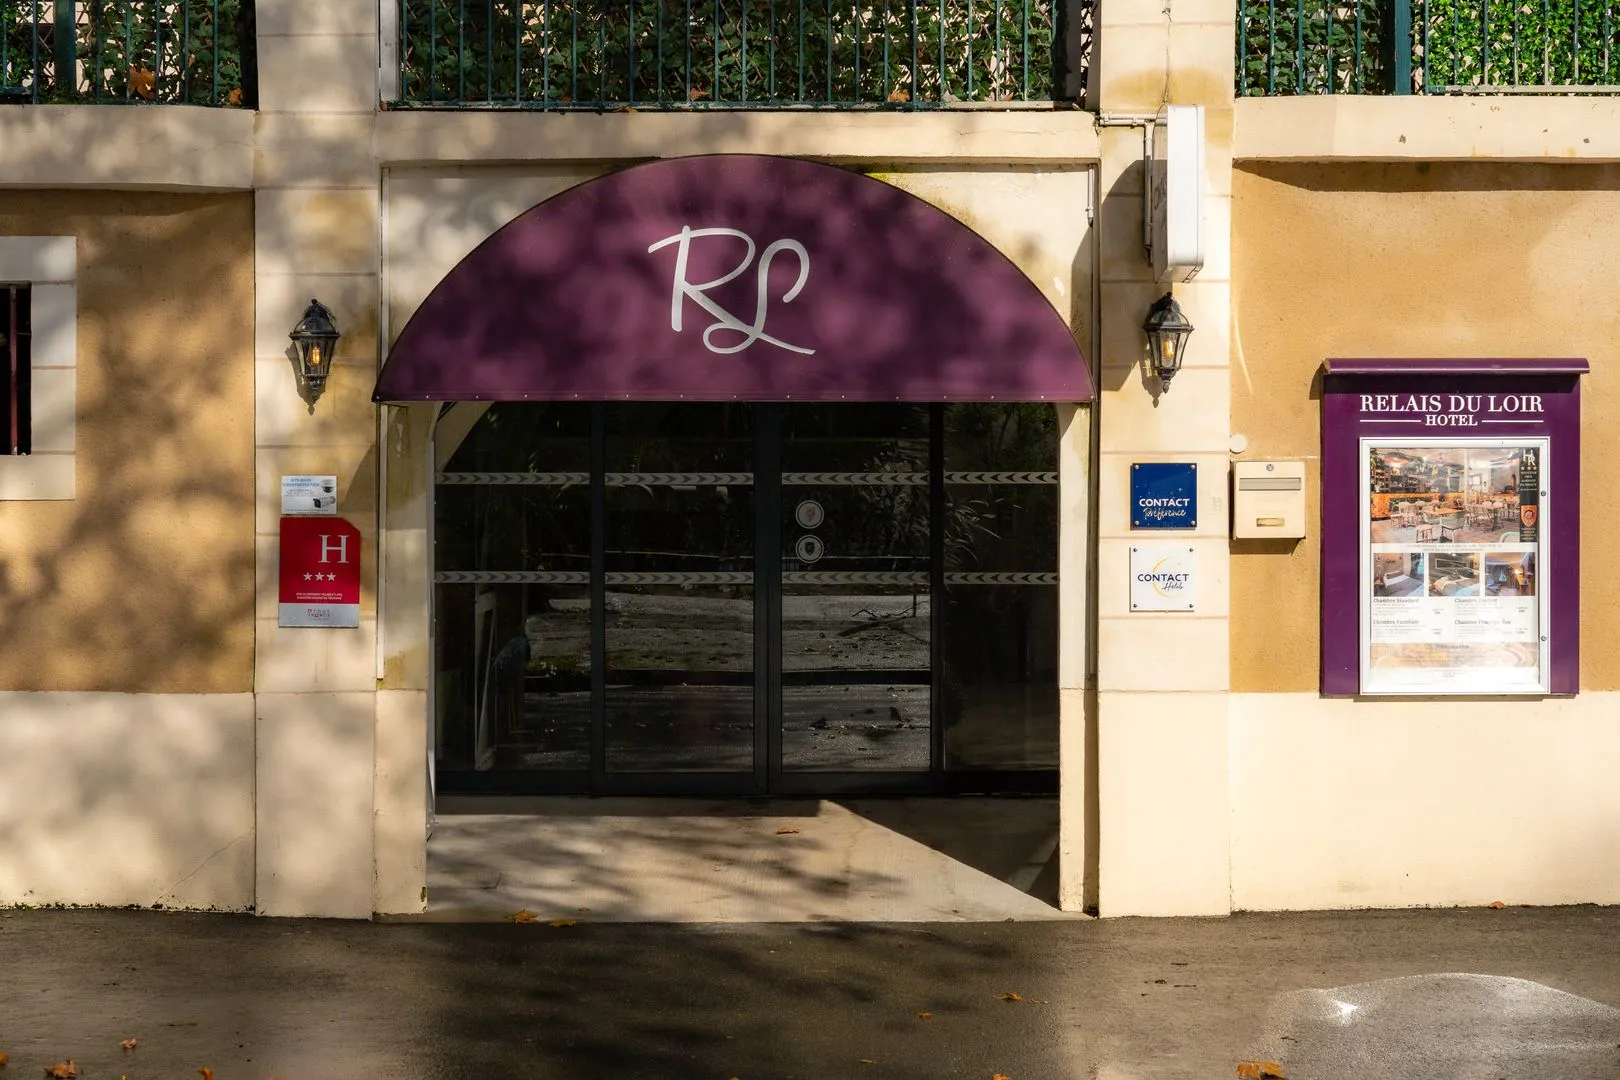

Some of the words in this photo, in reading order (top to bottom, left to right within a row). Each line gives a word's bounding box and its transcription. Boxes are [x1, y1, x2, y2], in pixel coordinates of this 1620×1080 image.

[1359, 394, 1442, 412] RELAIS
[1448, 395, 1482, 413] DU
[1487, 395, 1544, 413] LOIR
[1425, 414, 1478, 426] HOTEL
[1139, 498, 1190, 506] CONTACT
[318, 534, 350, 563] H
[1138, 574, 1189, 582] CONTACT
